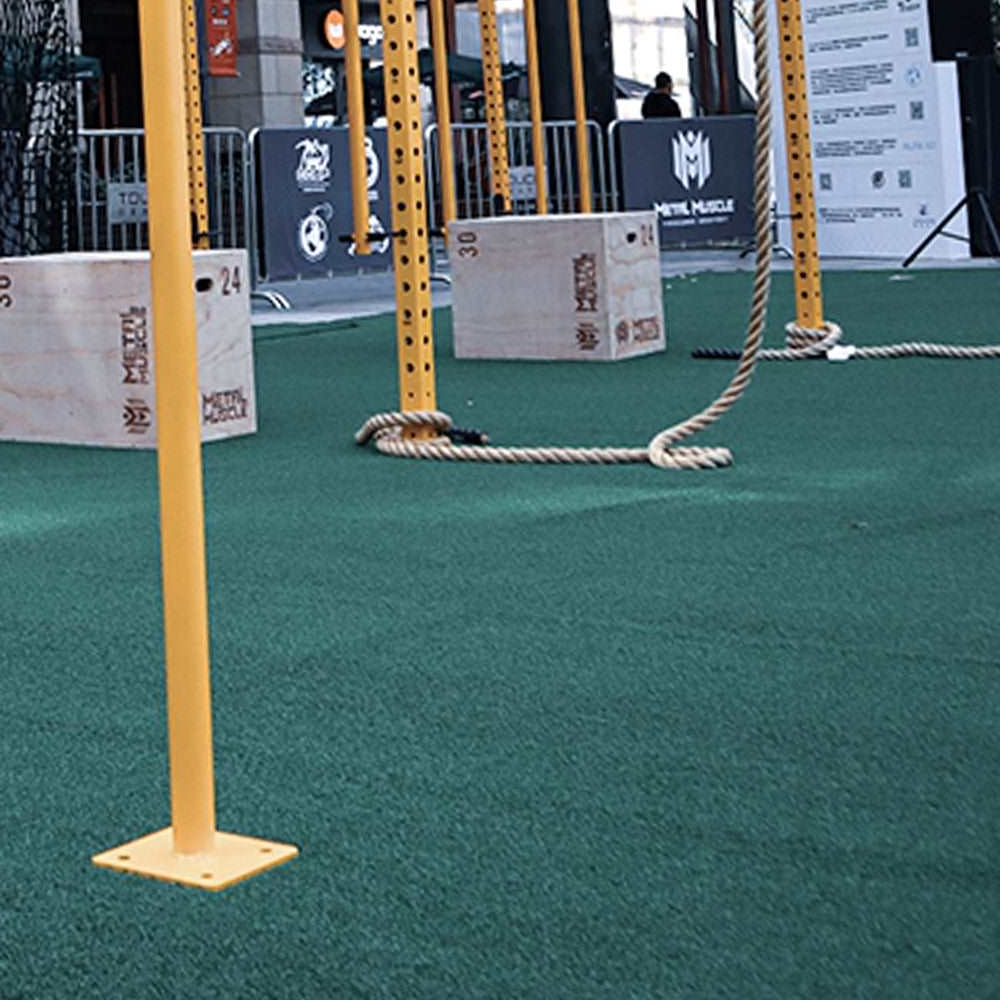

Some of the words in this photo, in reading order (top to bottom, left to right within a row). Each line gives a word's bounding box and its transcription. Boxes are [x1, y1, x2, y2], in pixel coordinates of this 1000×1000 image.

[691, 199, 734, 215] MUSCLE
[457, 230, 479, 259] 30
[220, 266, 242, 297] 24
[119, 312, 139, 385] METAL
[131, 305, 150, 385] MUSCLE
